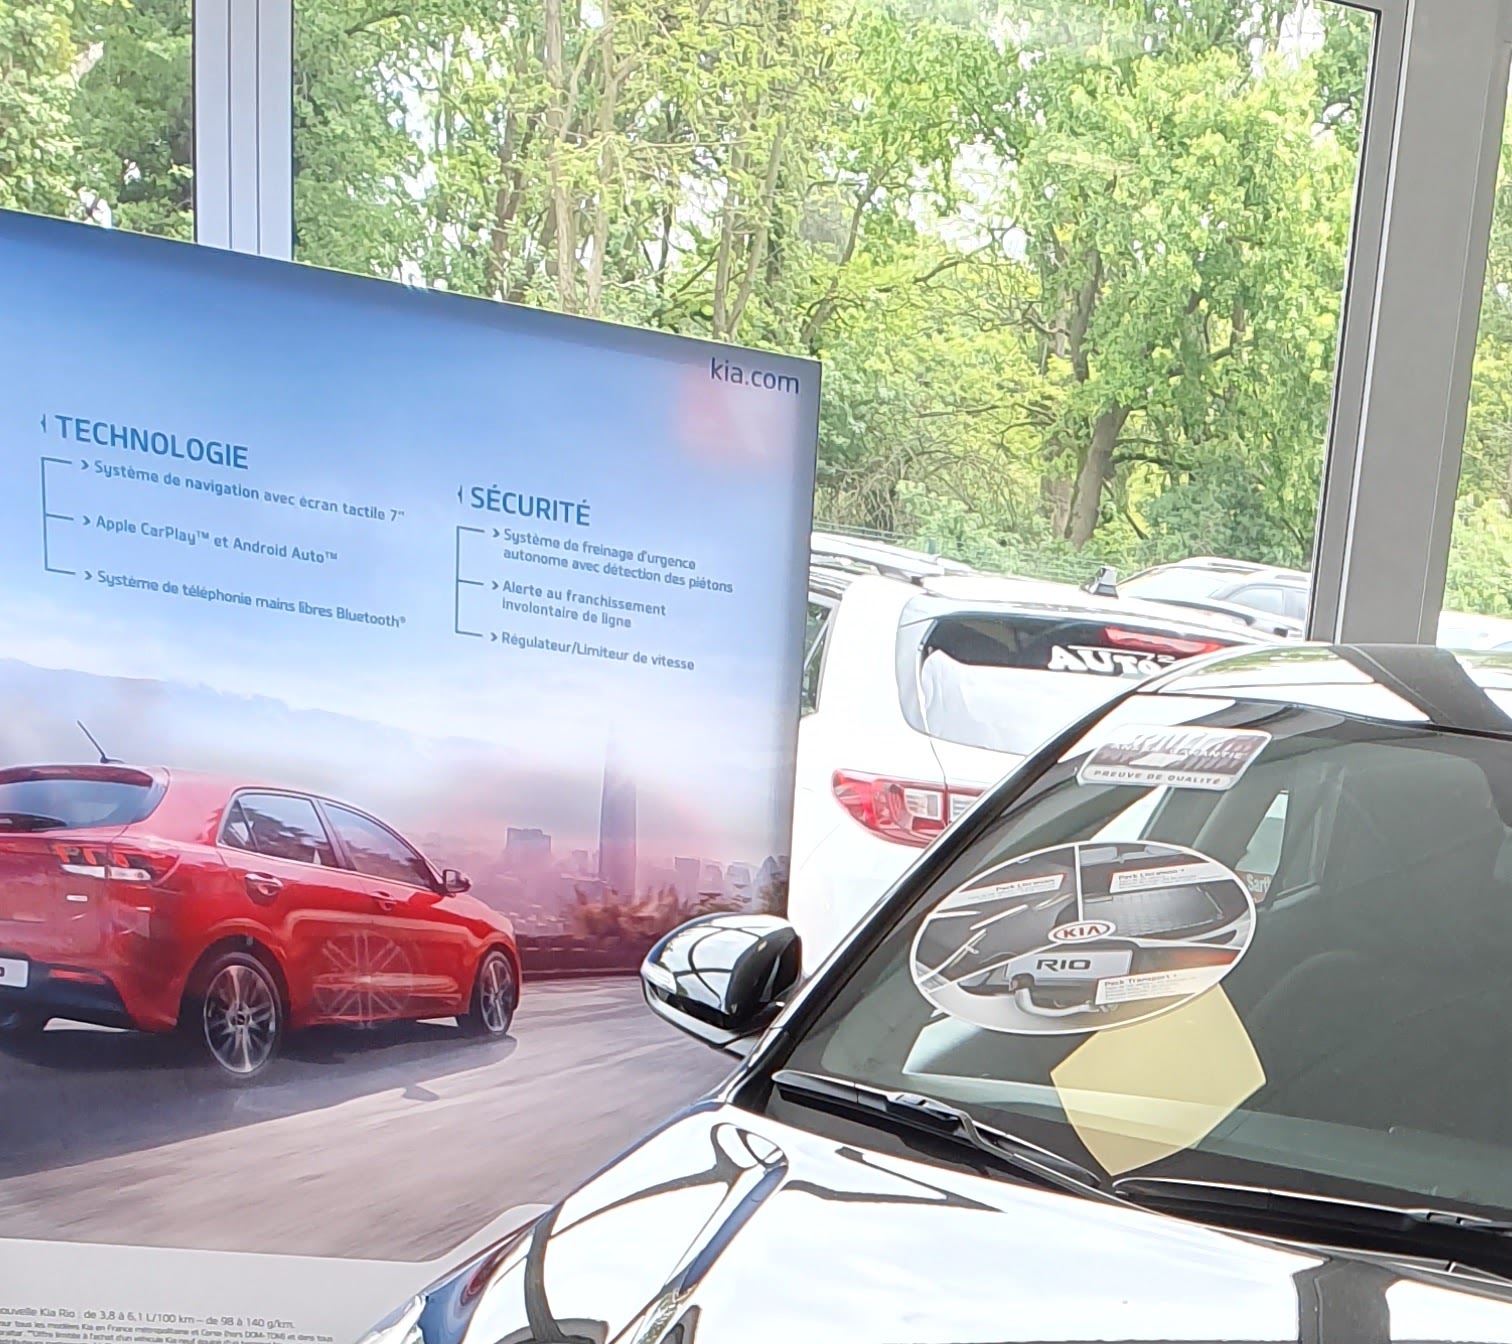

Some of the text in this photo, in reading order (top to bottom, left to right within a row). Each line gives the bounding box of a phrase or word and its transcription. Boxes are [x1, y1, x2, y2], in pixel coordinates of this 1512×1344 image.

[711, 356, 799, 395] kia.com
[54, 414, 249, 469] TECHNOLOGIE
[94, 460, 159, 484] Système
[163, 472, 181, 487] de
[185, 477, 259, 501] navigation
[263, 489, 296, 507] avec
[299, 494, 339, 513] écran
[342, 503, 386, 521] tactile
[470, 484, 591, 527] SÉCURITÉ
[96, 515, 137, 536] Apple
[213, 535, 229, 549] et
[233, 537, 287, 559] Android
[504, 528, 696, 570] Système de freinage d'urgence
[503, 548, 734, 594] autonome avec détection des piétons
[97, 570, 159, 592] Système
[162, 579, 179, 595] de
[182, 583, 252, 607] téléphonie
[255, 597, 296, 613] mains
[298, 601, 333, 619] libres
[502, 580, 667, 617] Alerte au franchissement
[582, 610, 598, 623] de
[601, 613, 632, 629] ligne
[632, 651, 648, 665] de
[651, 655, 695, 671] vitesse
[1093, 771, 1222, 785] PREUVE DE QUALITÉ
[1063, 926, 1101, 938] KIA
[1036, 959, 1091, 972] RIO
[84, 1310, 97, 1319] de
[118, 1311, 125, 1320] à
[145, 1313, 177, 1323] L/100
[178, 1314, 195, 1323] km
